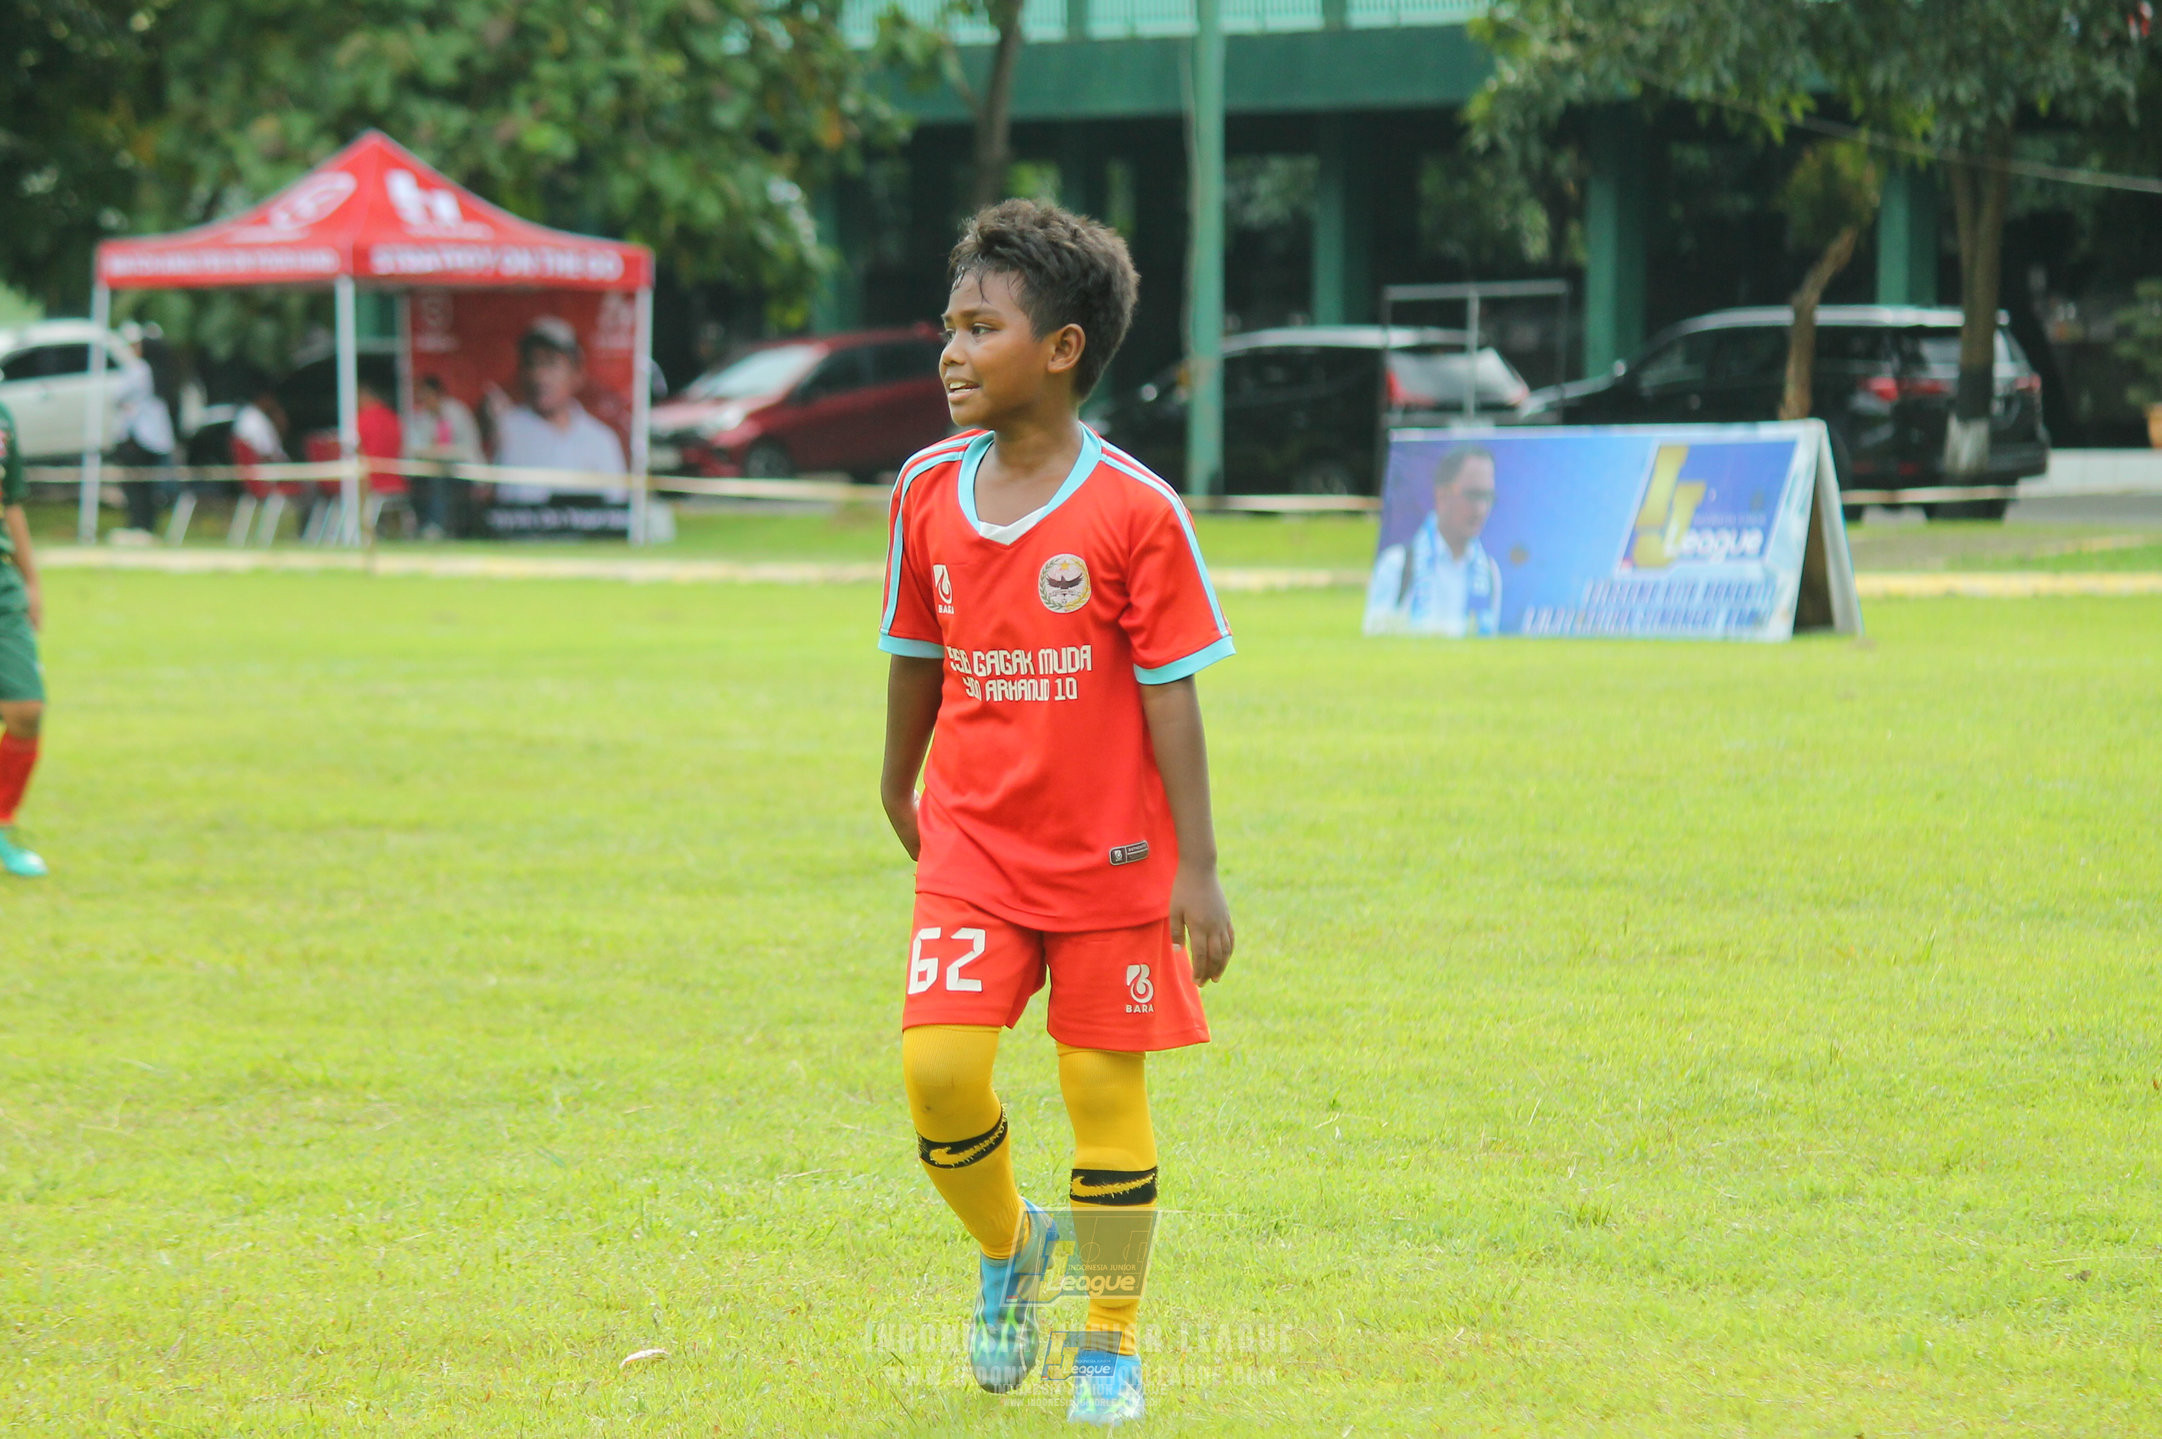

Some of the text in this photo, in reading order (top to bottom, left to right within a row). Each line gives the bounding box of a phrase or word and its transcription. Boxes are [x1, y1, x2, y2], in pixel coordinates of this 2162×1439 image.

[1663, 518, 1764, 563] League
[972, 649, 1036, 677] GAGAK
[1038, 645, 1092, 675] MUDA
[1054, 677, 1078, 701] 10
[908, 927, 986, 995] 62
[1126, 1004, 1155, 1014] BARA
